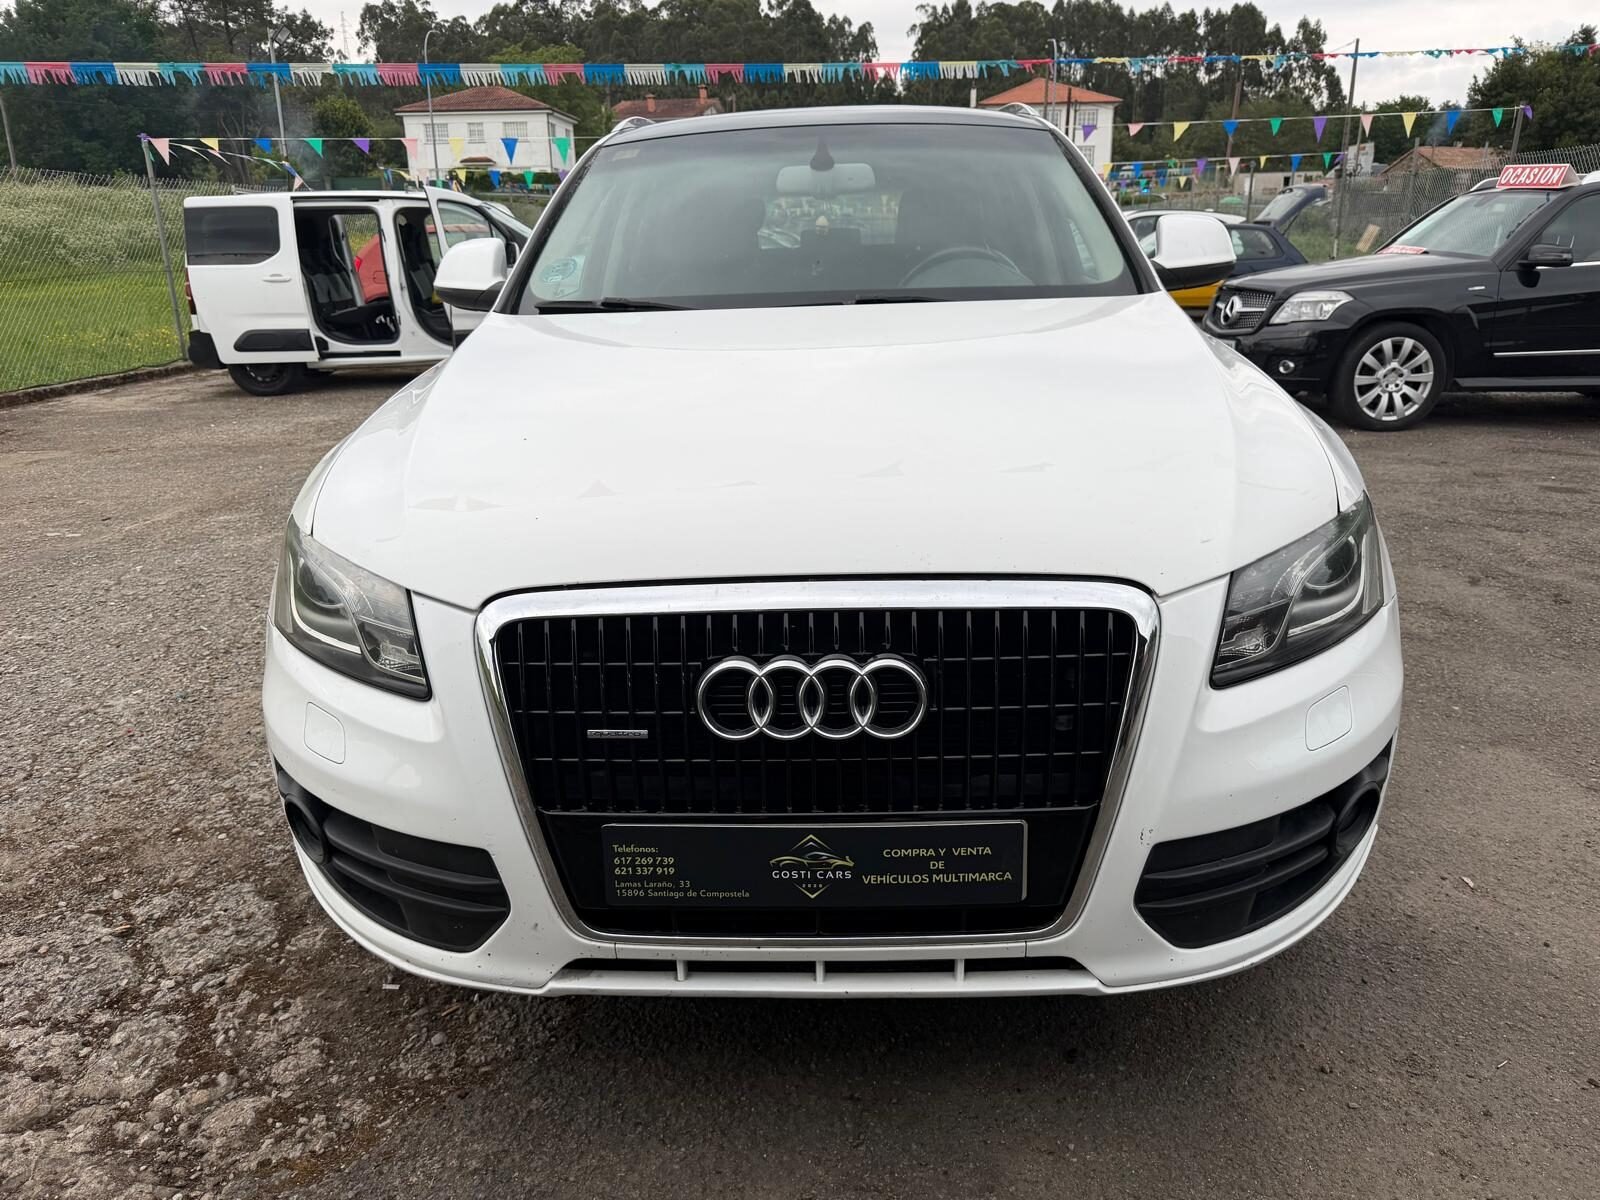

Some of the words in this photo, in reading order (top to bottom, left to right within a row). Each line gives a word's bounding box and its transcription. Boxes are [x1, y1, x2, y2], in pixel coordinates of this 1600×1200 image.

[1500, 166, 1566, 185] OCASION
[883, 848, 936, 858] COMPRA
[938, 848, 946, 857] Y
[952, 846, 992, 856] VENTA
[614, 857, 632, 865] 617
[635, 857, 653, 865] 269
[656, 857, 675, 865] 739
[930, 861, 945, 869] DE
[614, 867, 632, 875] 621
[635, 867, 653, 875] 337
[656, 867, 675, 875] 919
[772, 870, 811, 879] GOSTI
[816, 870, 852, 879] CARS
[862, 873, 929, 884] VEHÍCULOS
[932, 871, 1013, 883] MULTIMARCA
[615, 880, 641, 888] Lamas
[679, 880, 691, 888] 33
[616, 889, 645, 897] 15896
[648, 889, 684, 899] Santiago
[687, 889, 697, 897] de
[700, 889, 750, 899] Compostela
